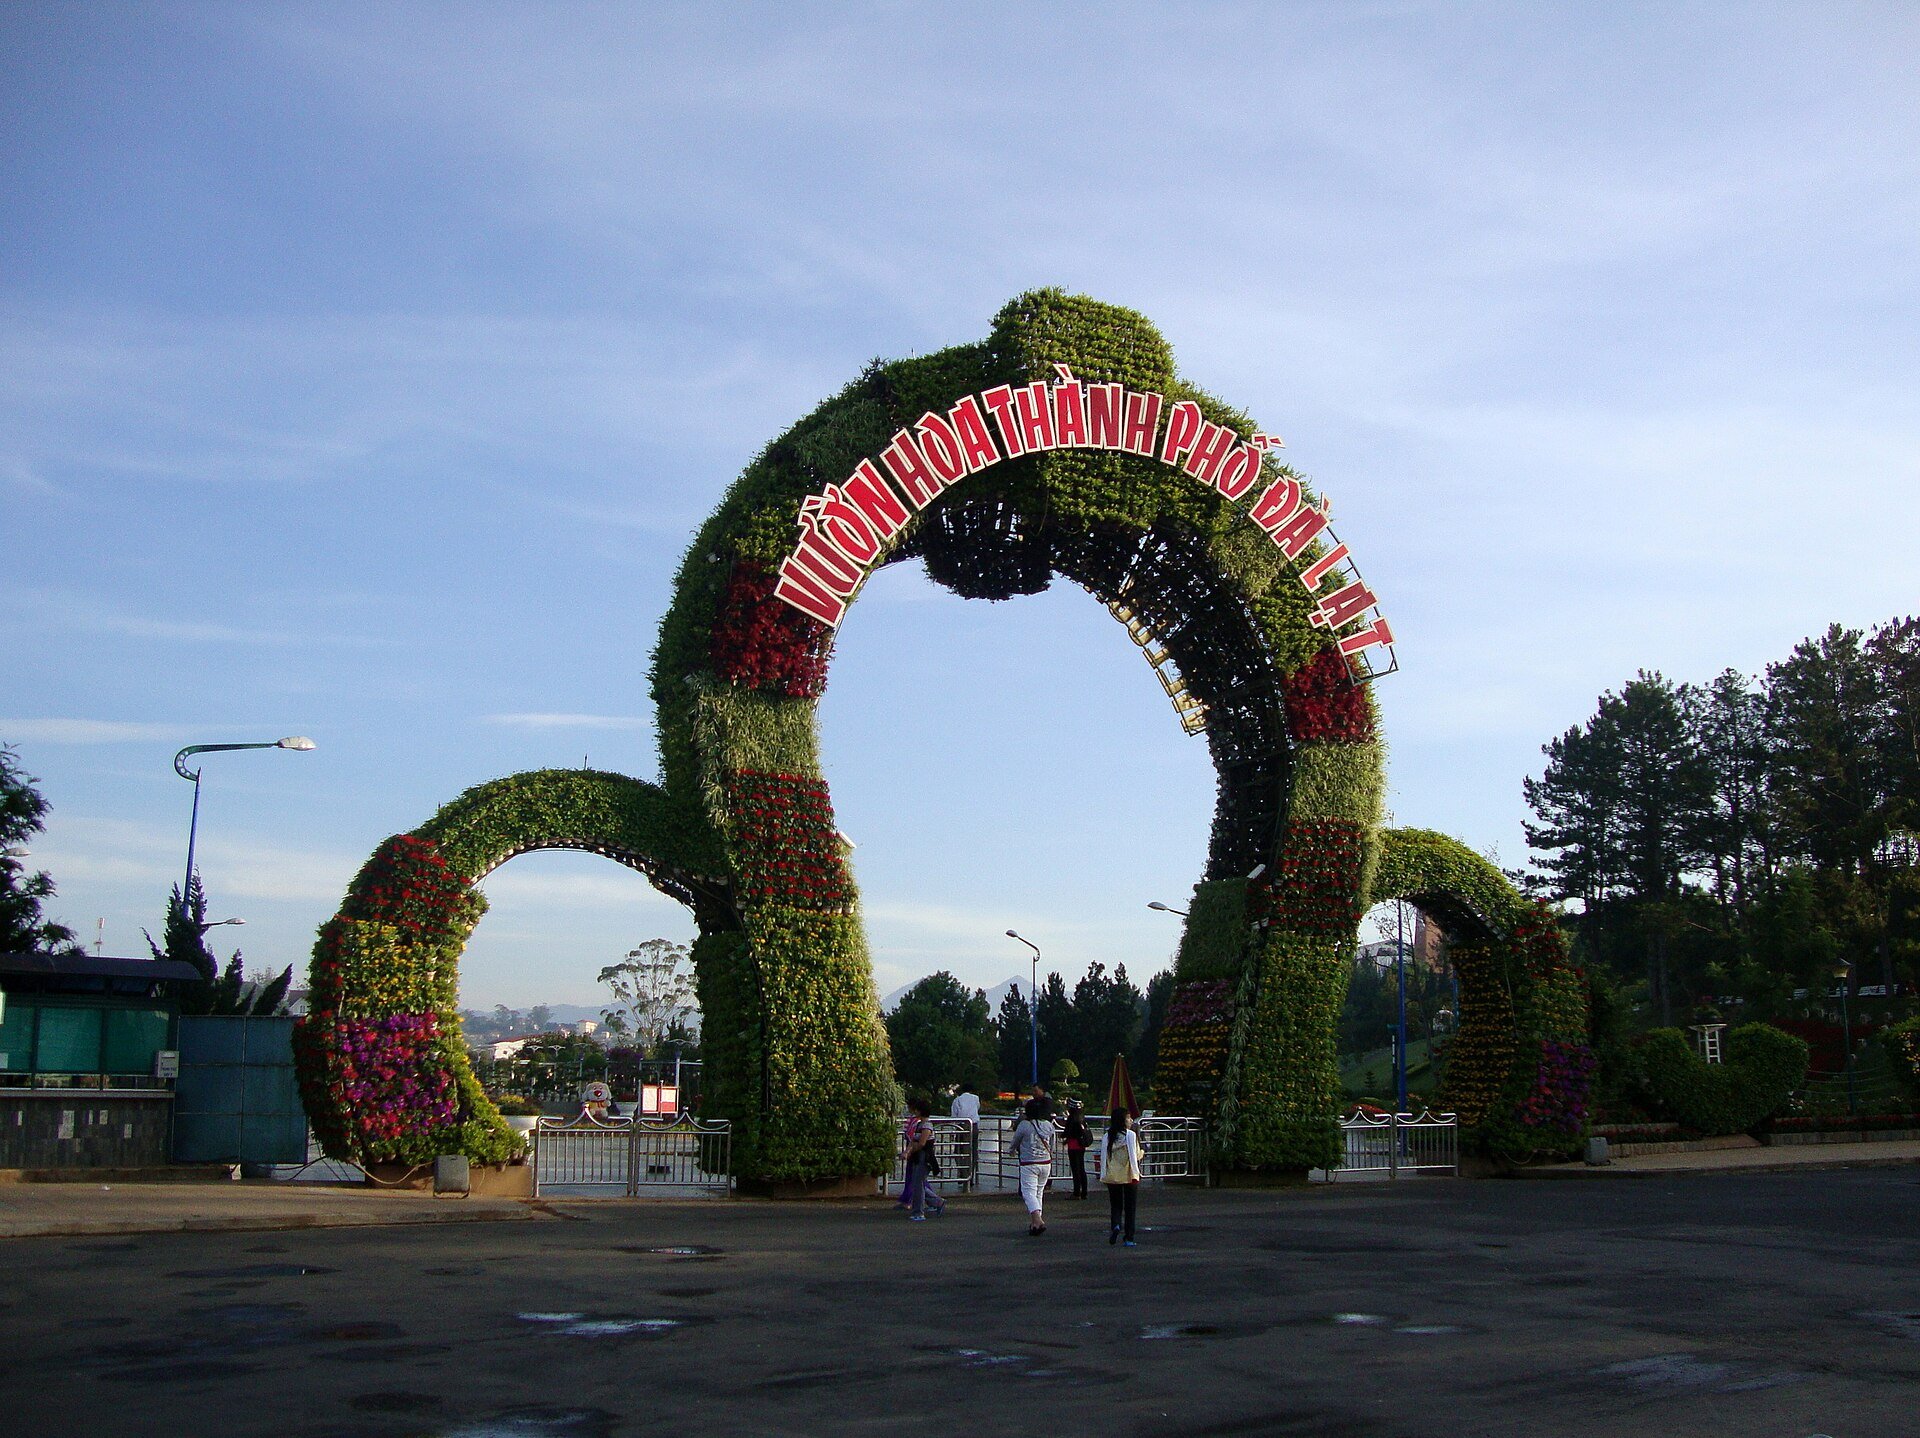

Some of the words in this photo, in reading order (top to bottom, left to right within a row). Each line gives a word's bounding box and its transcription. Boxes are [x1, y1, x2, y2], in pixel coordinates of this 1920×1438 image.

[773, 458, 912, 628] VƯỜN
[879, 395, 1001, 511] HOA
[981, 363, 1164, 459] THÀNH
[1160, 401, 1286, 502] PHỐ
[1248, 474, 1332, 561] ĐÀ
[1299, 542, 1397, 656] LẠT
